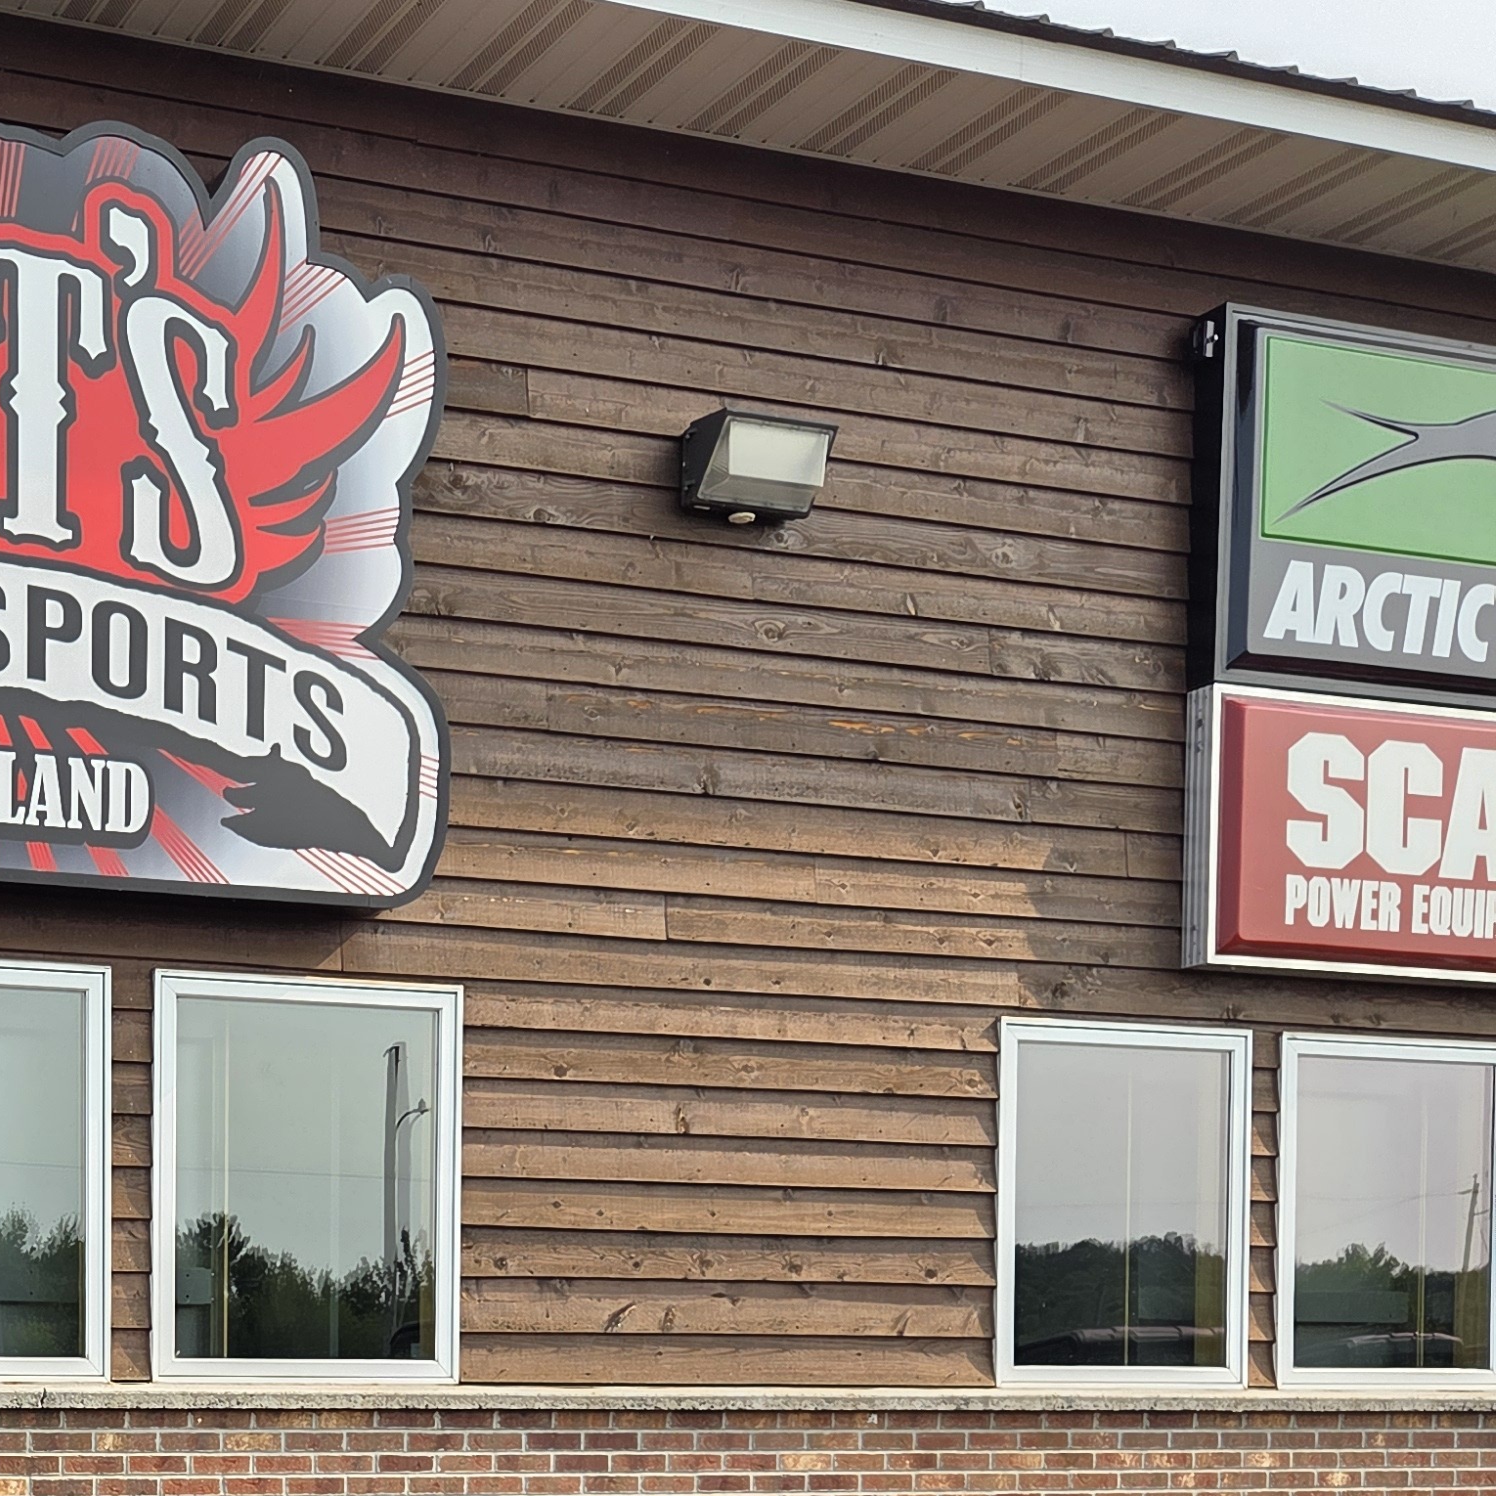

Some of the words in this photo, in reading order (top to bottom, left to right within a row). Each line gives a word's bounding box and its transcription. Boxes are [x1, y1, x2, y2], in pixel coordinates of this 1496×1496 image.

[1262, 559, 1496, 663] ARCTIC
[1286, 731, 1496, 882] SCA
[1284, 873, 1402, 933] POWER
